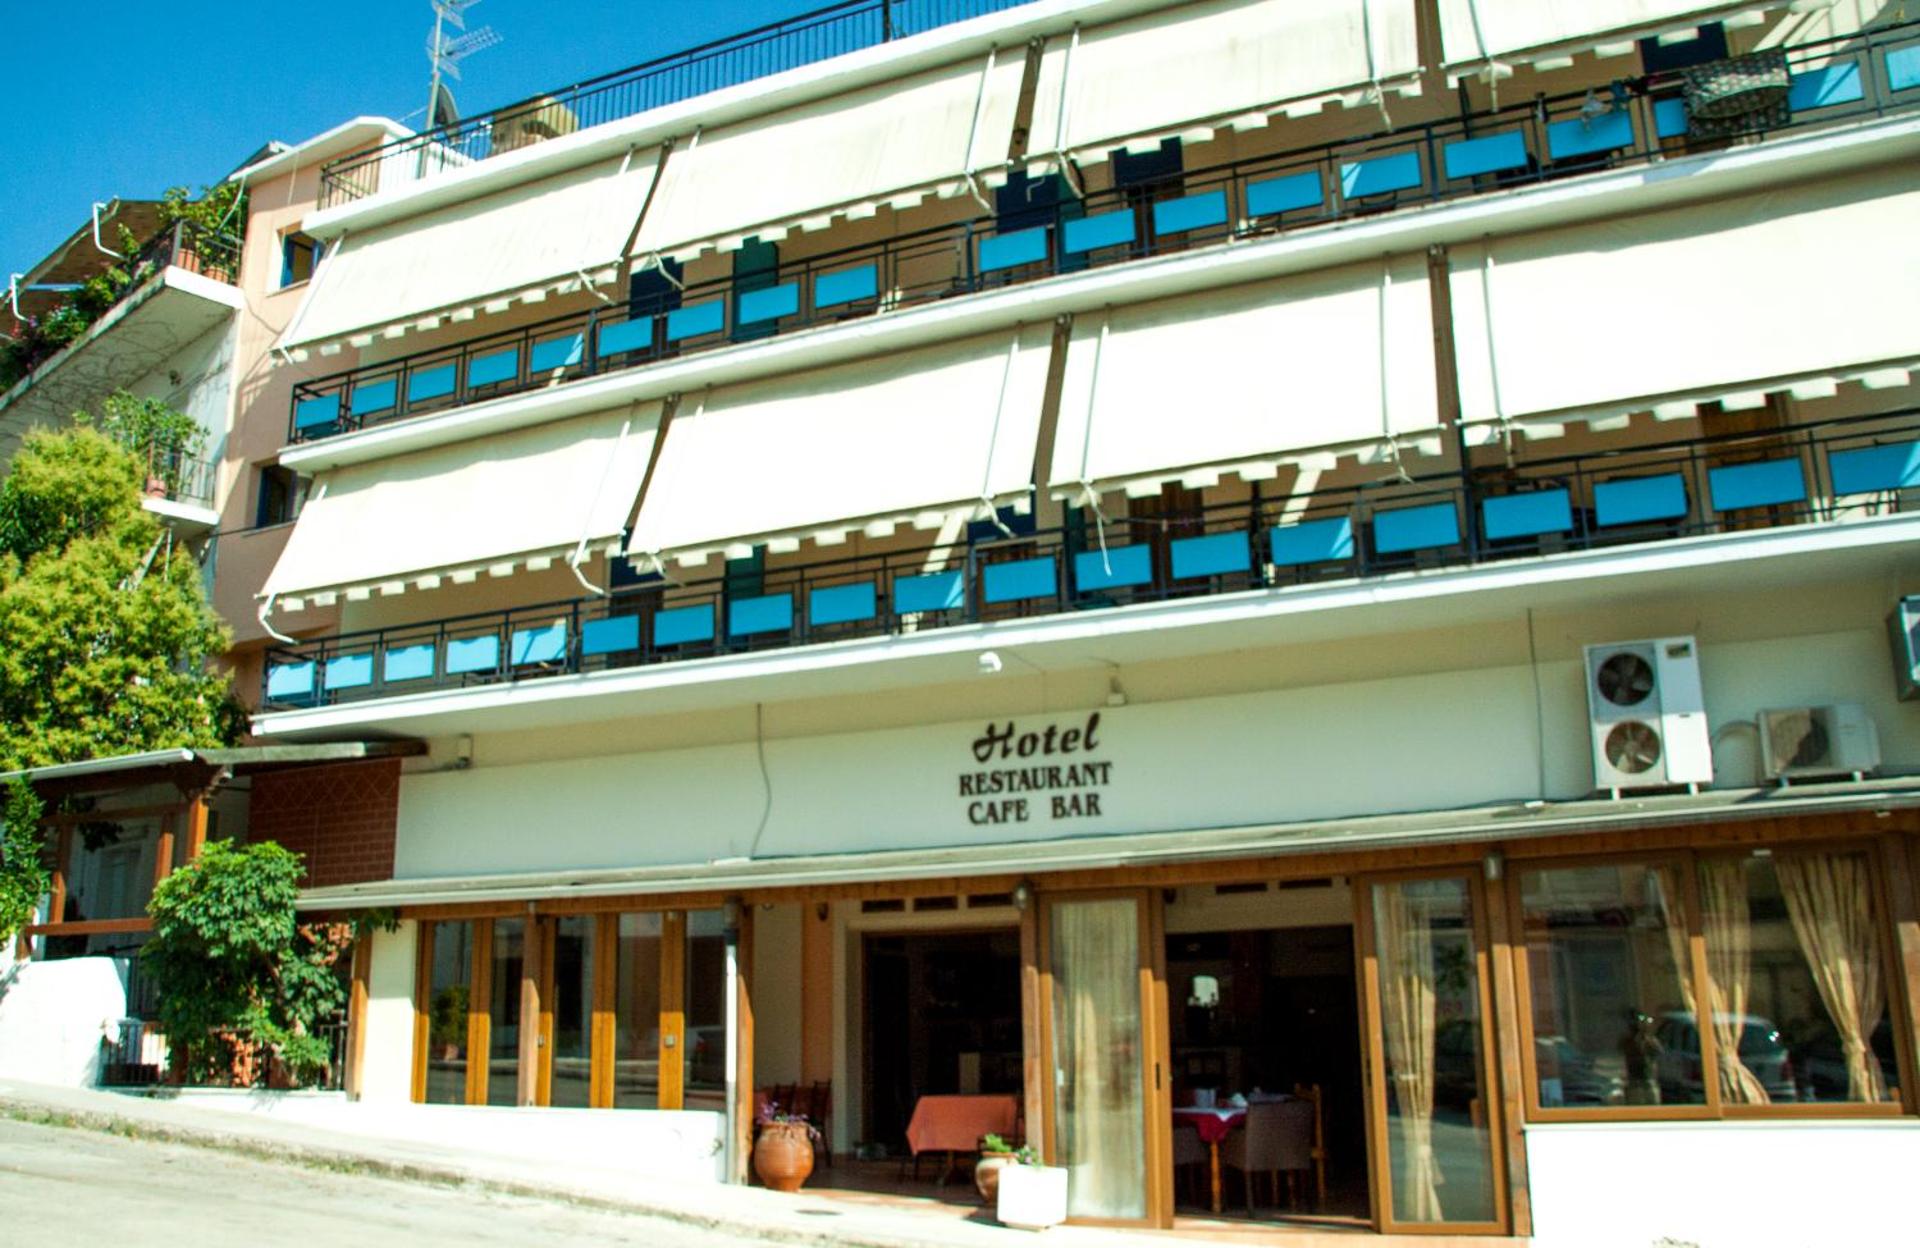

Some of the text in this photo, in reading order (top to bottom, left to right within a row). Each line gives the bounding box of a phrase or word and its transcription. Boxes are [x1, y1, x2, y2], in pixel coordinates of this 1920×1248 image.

[972, 712, 1100, 763] Hotel
[959, 761, 1112, 796] RESTAURANT
[968, 793, 1101, 825] CAFE BAR
